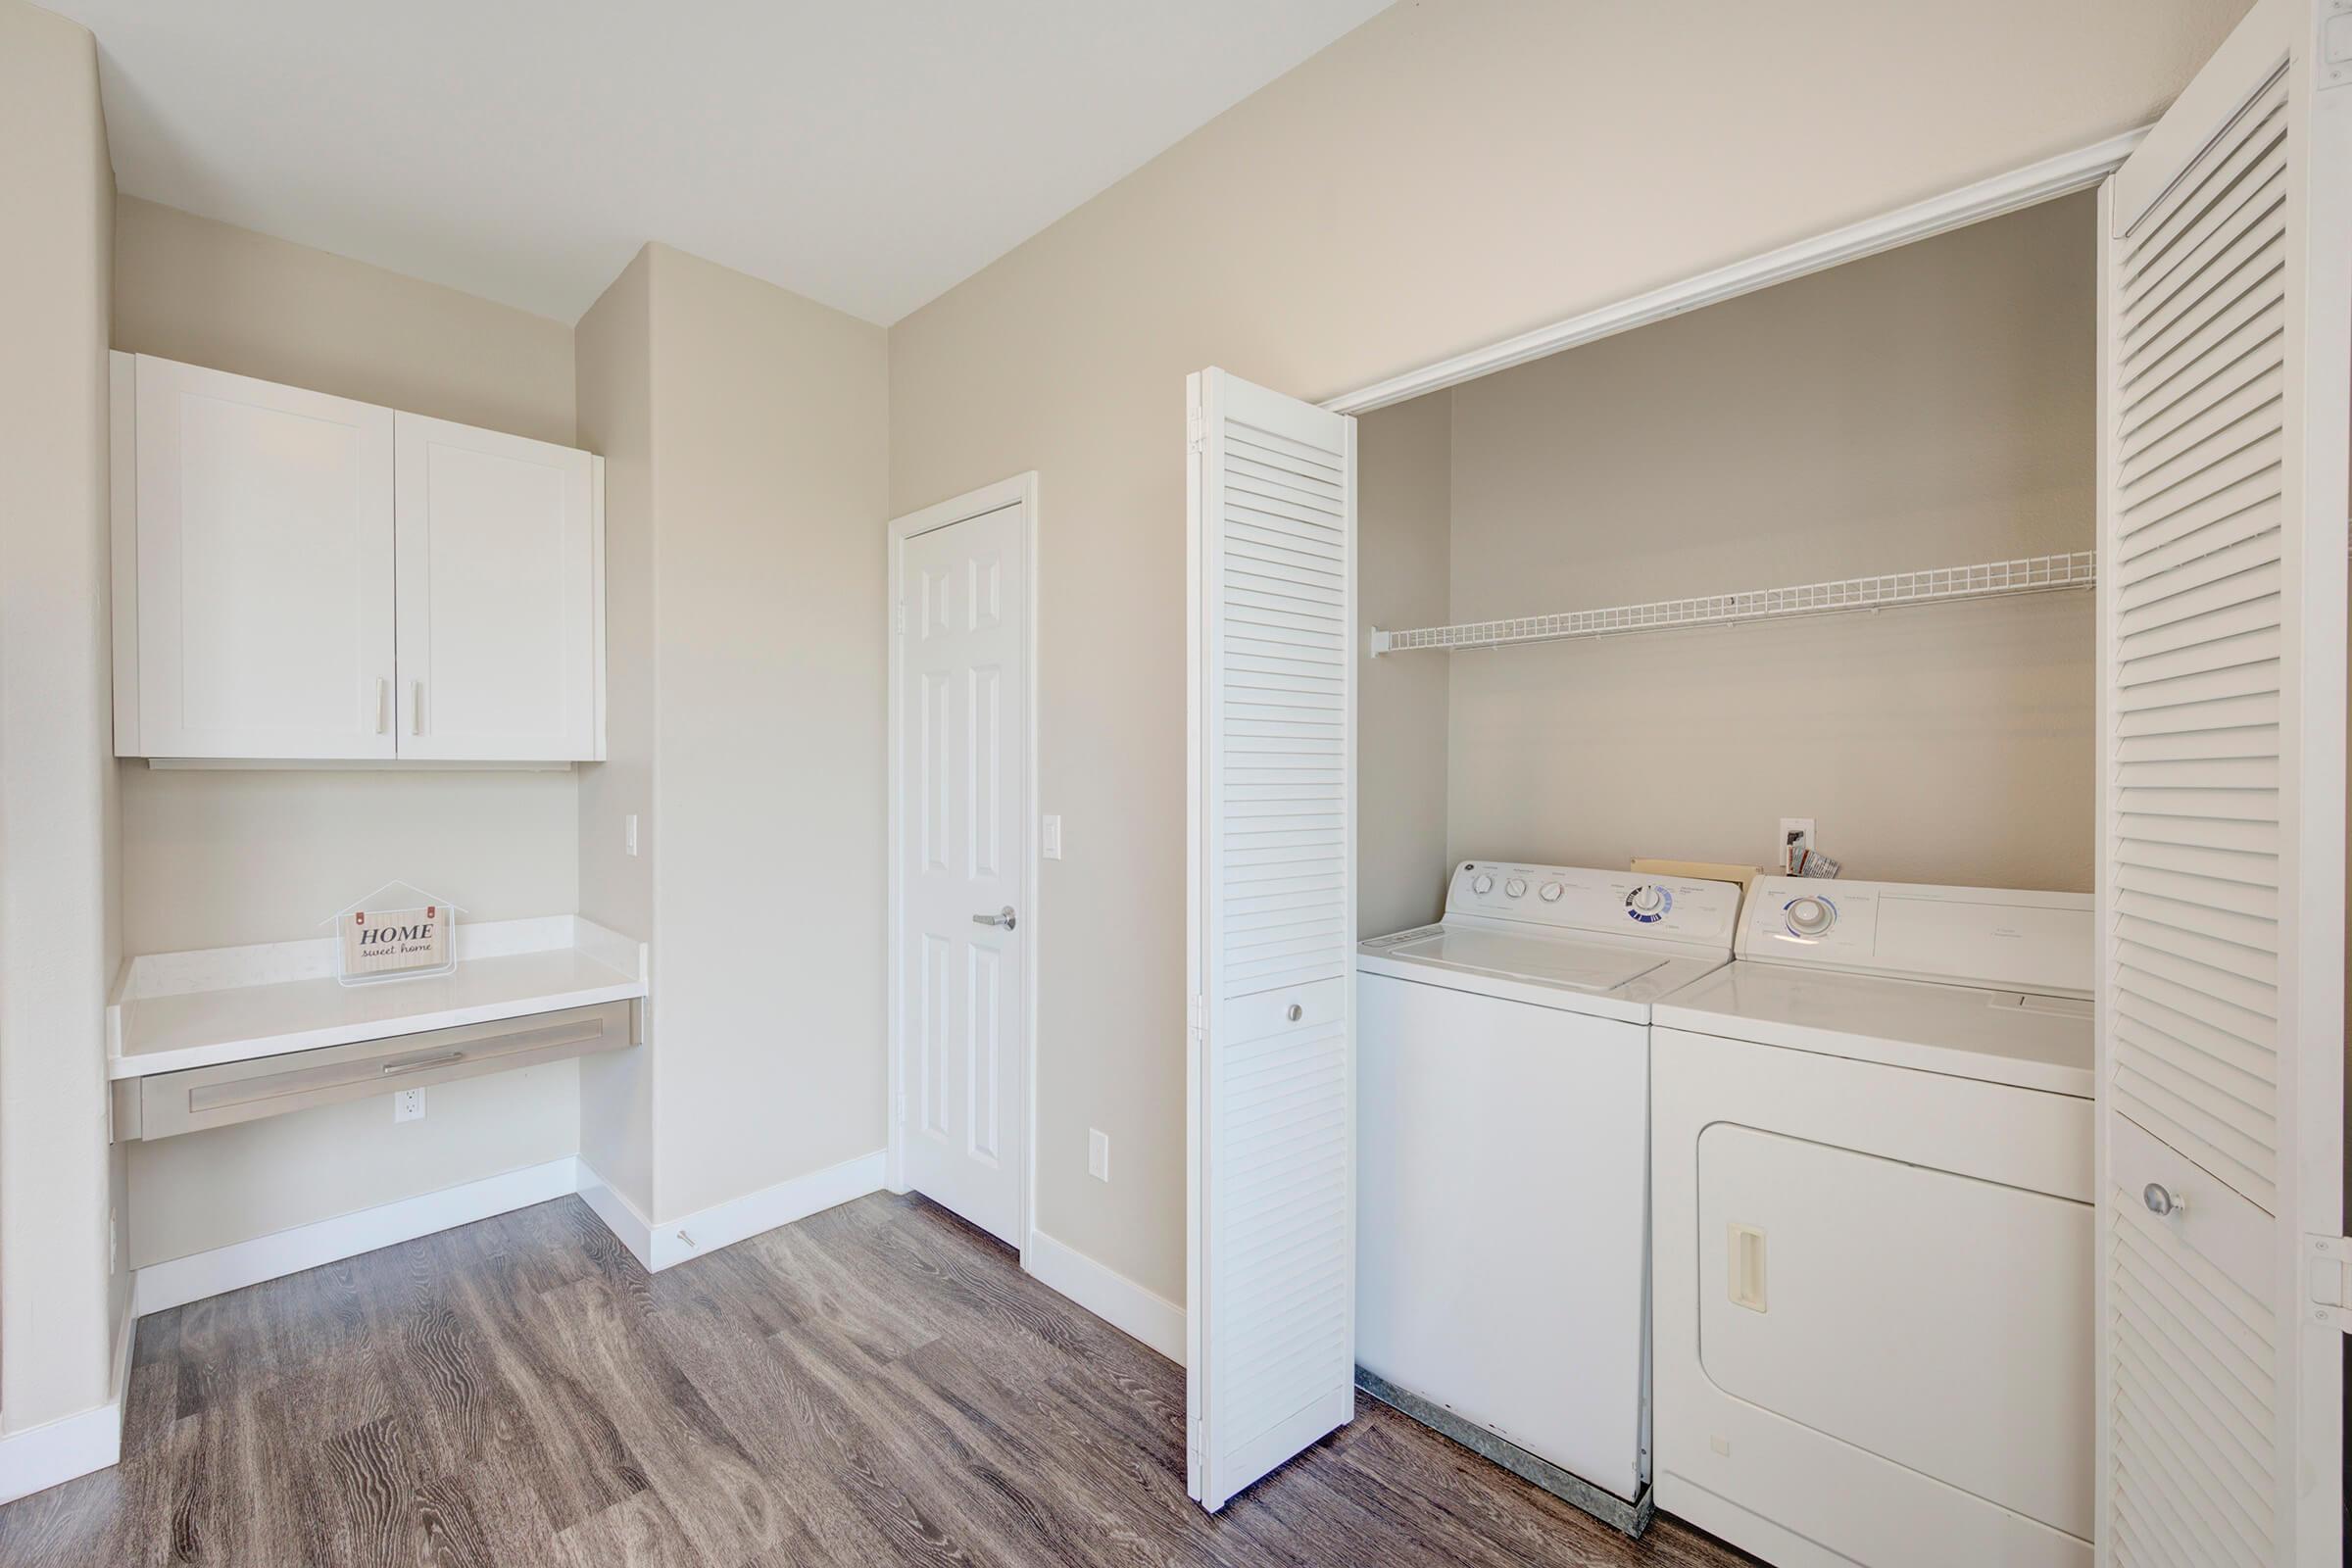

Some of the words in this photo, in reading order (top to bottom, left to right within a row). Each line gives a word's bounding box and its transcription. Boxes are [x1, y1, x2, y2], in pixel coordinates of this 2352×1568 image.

[359, 923, 434, 945] HOME
[362, 945, 396, 957] sweet
[400, 942, 432, 954] home
